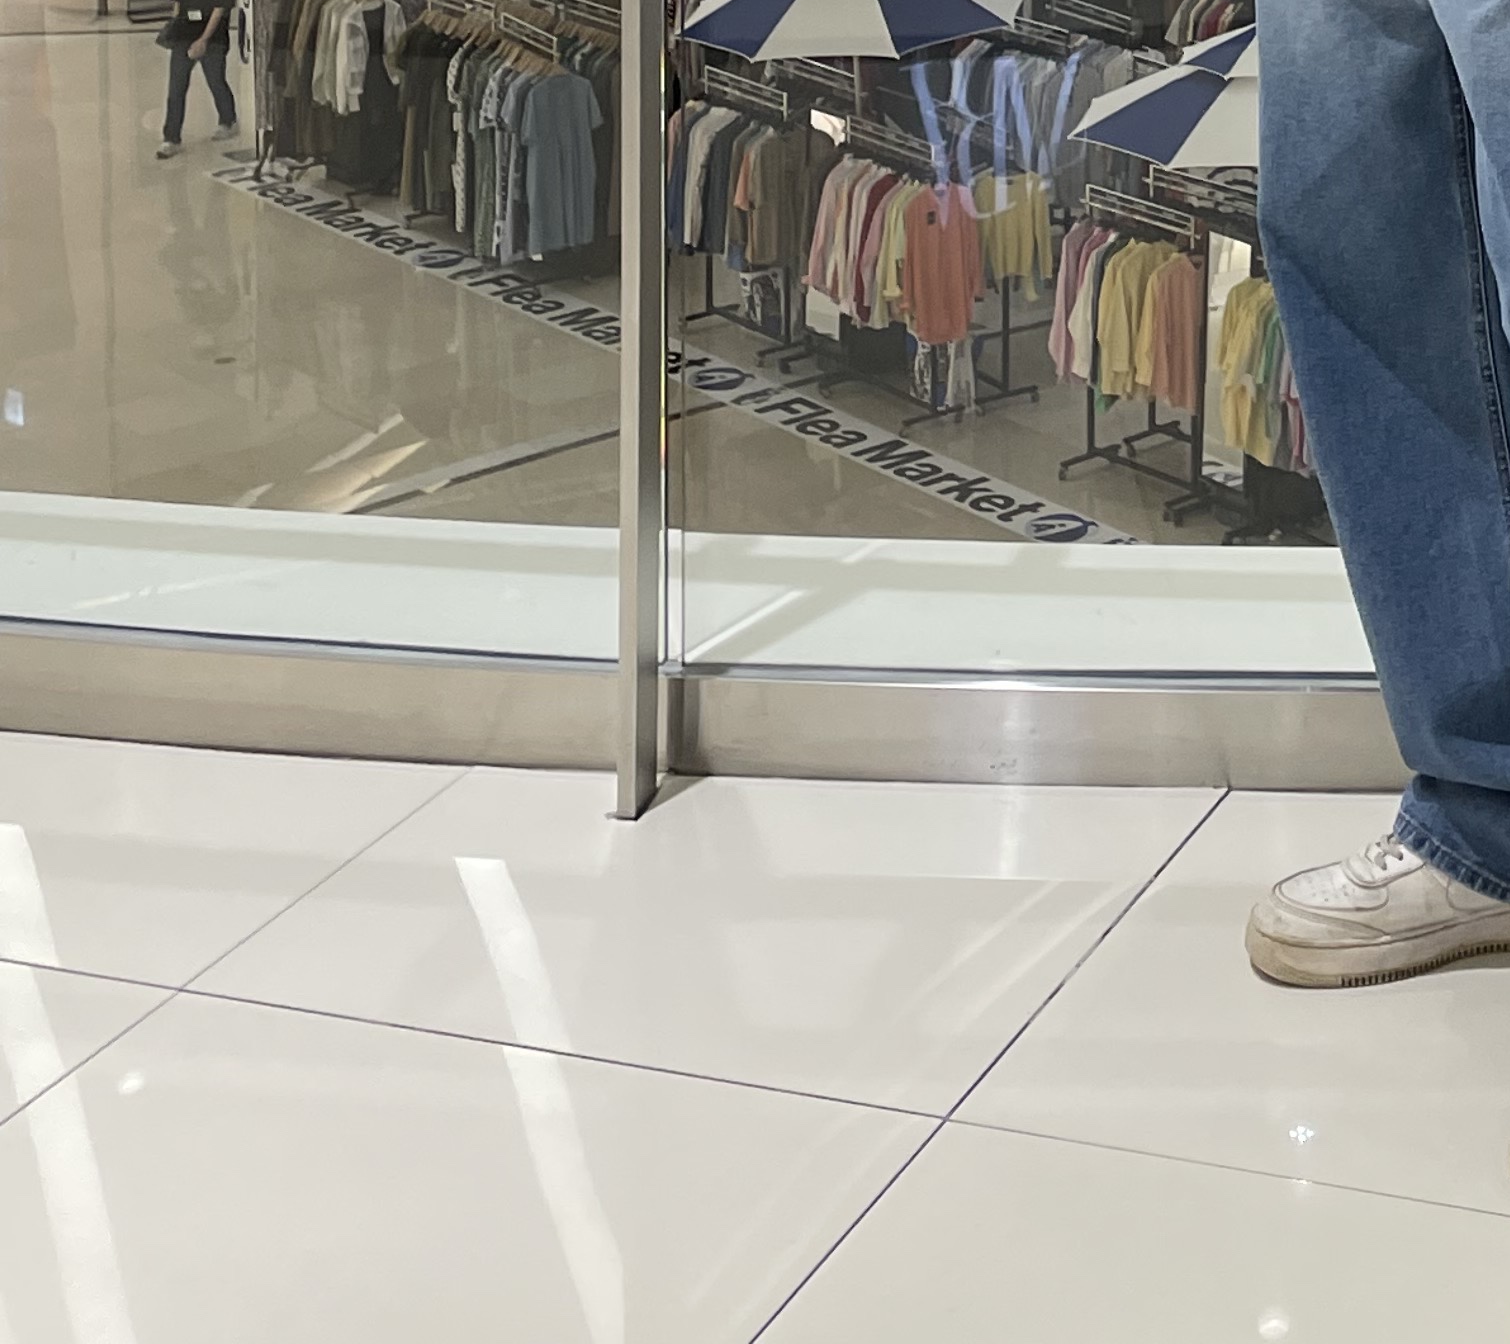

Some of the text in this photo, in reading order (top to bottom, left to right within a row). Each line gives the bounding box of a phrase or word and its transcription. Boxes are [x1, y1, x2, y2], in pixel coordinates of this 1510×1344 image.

[306, 197, 437, 256] Market
[467, 272, 567, 316] Flea
[754, 396, 1048, 524] Flea Market
